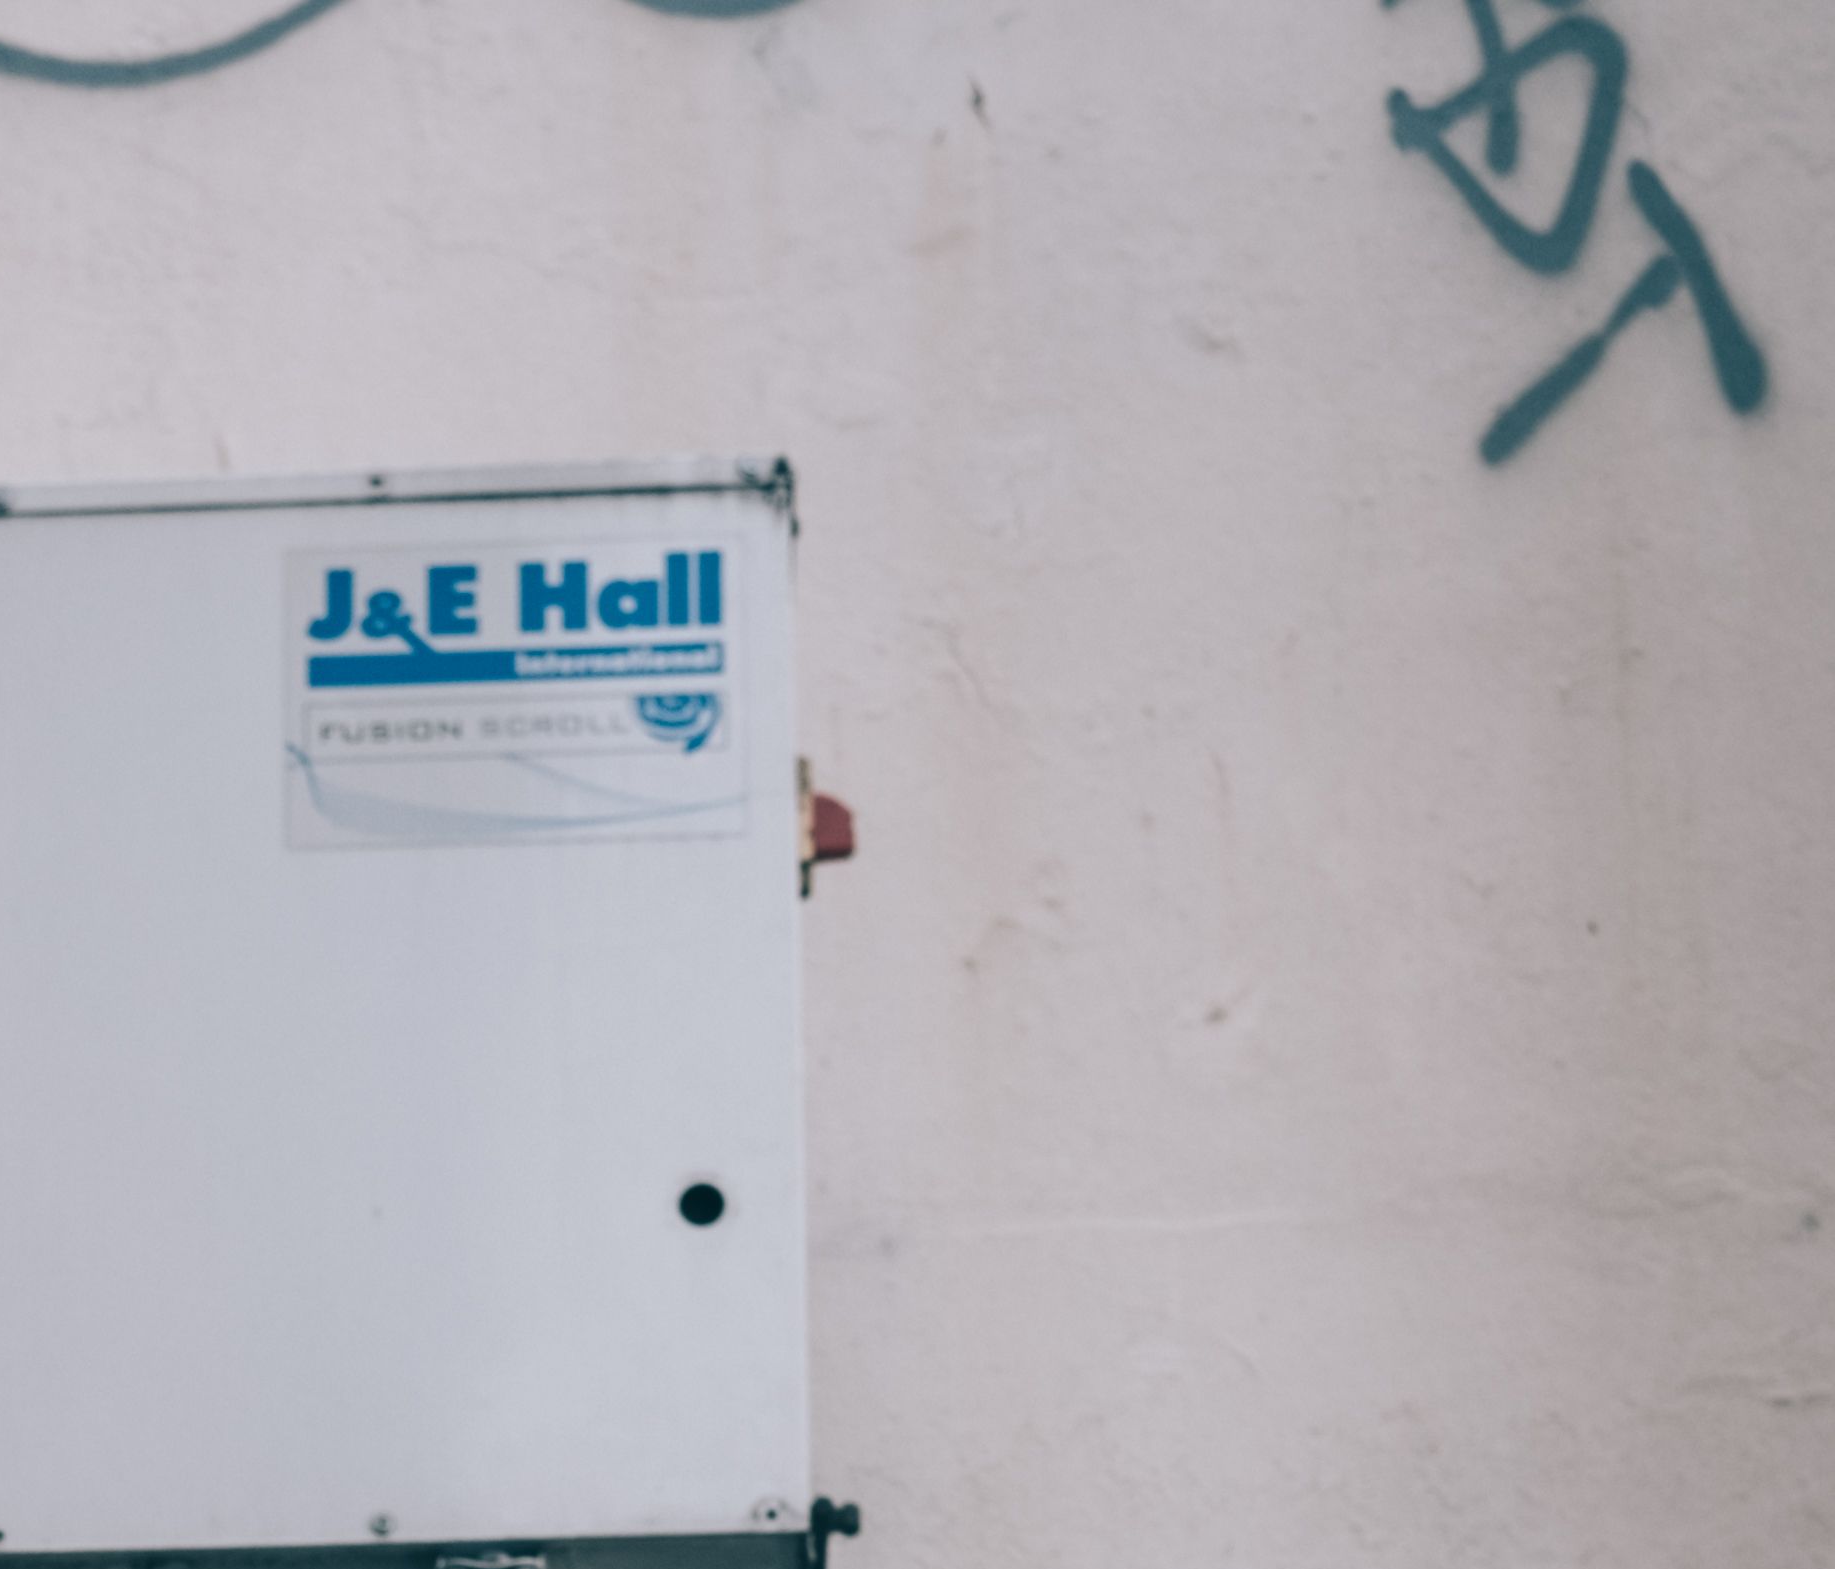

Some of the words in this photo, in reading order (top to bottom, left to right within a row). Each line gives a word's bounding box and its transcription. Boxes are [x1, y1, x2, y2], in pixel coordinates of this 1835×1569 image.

[306, 563, 480, 646] J&E
[517, 550, 723, 633] Hall
[317, 718, 464, 746] FUSION
[478, 712, 630, 742] SCROLL
